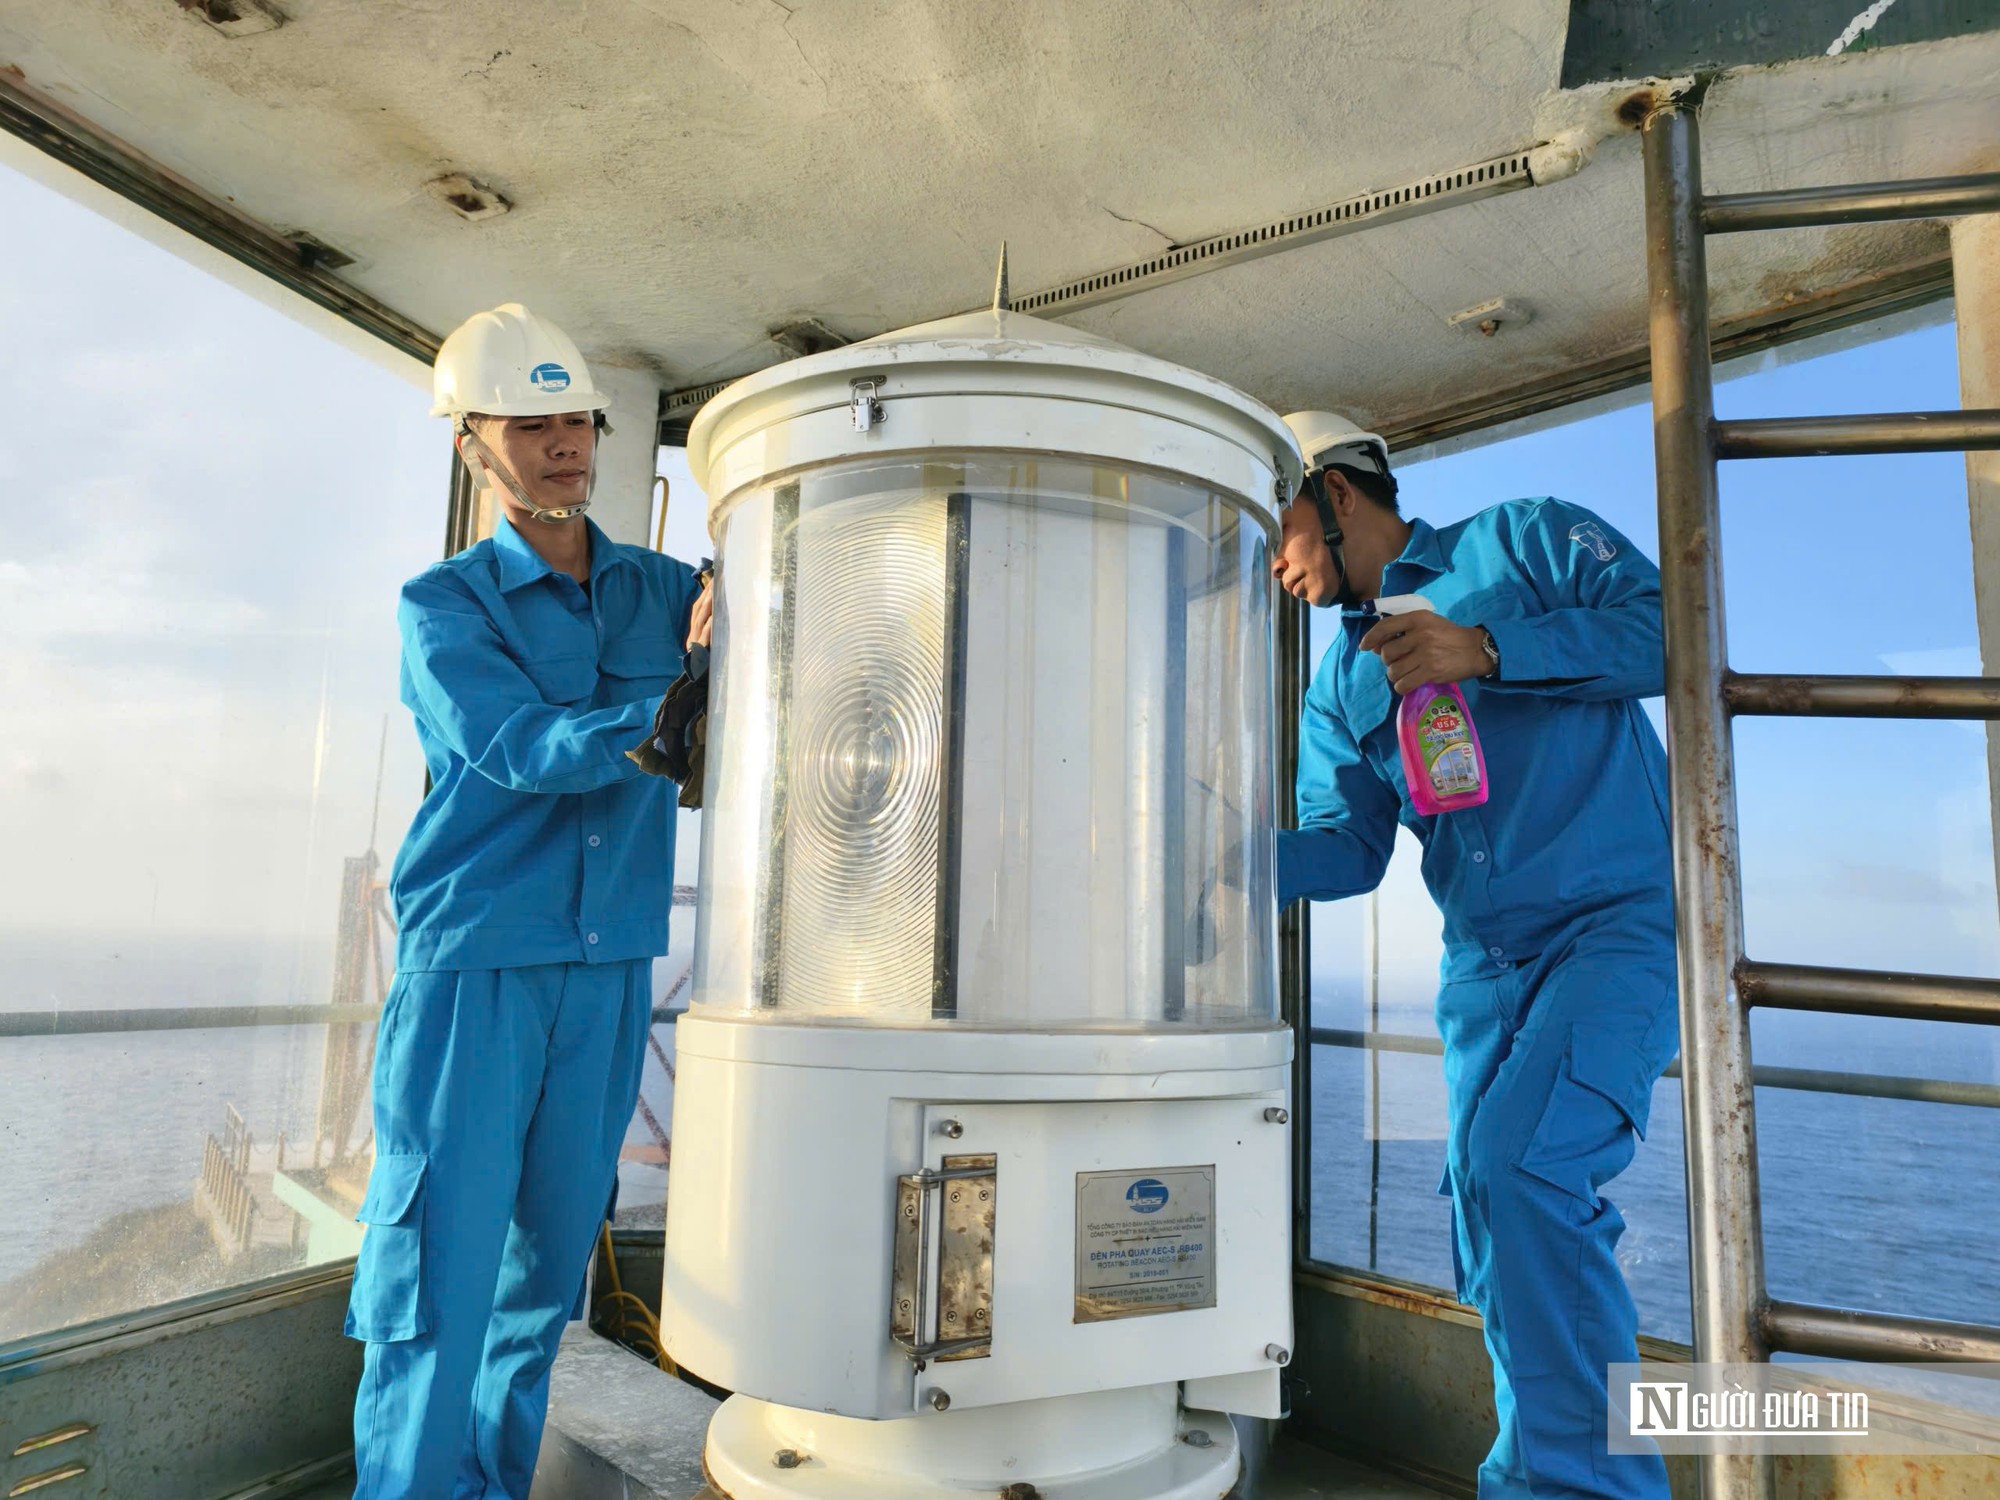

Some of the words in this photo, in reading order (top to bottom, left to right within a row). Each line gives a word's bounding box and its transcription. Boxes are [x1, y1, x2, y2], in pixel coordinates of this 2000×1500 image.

[1437, 720, 1456, 729] USA
[1090, 1250, 1107, 1261] ĐÈN
[1109, 1251, 1126, 1259] PHA
[1128, 1248, 1150, 1258] QUAY
[1151, 1246, 1175, 1255] AEC-S
[1097, 1260, 1129, 1269] ROTATING
[1130, 1258, 1157, 1267] BEACON
